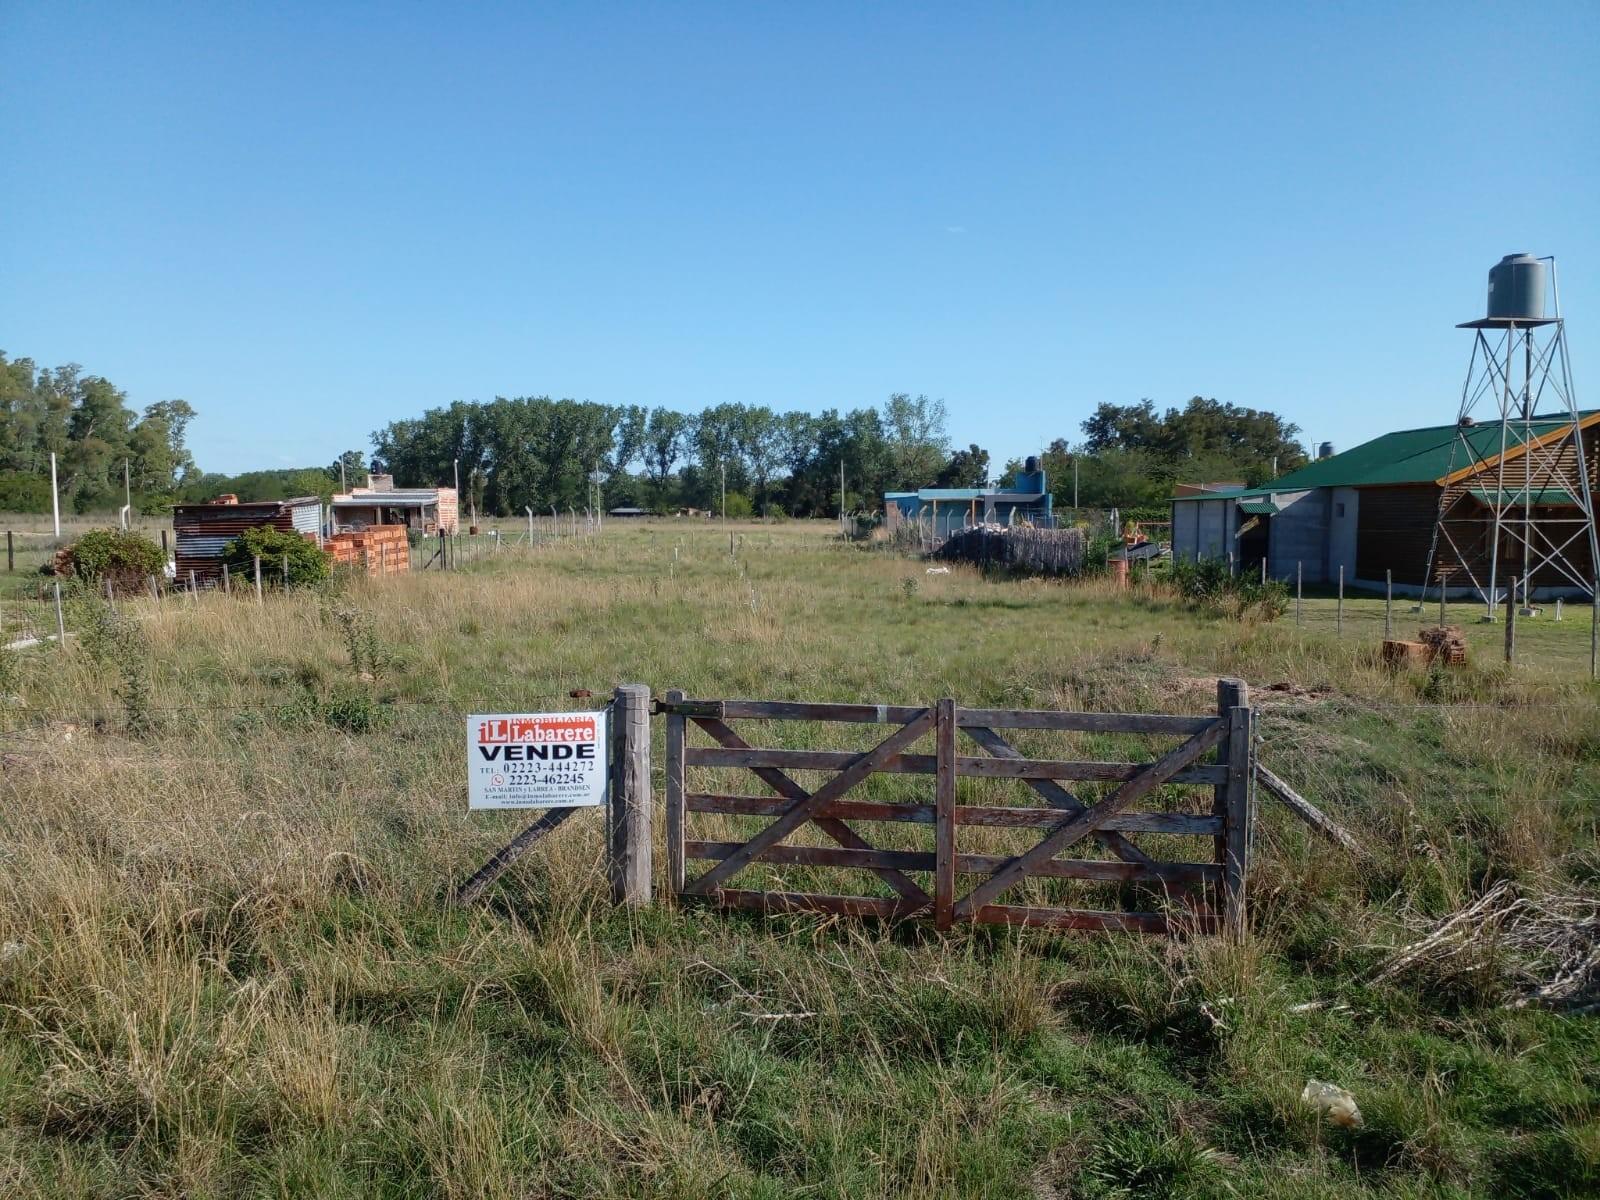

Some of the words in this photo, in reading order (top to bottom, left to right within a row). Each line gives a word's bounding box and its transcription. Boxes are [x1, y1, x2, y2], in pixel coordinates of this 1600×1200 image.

[511, 716, 595, 725] INMOBILIARIA
[512, 724, 594, 742] Labarere
[478, 744, 595, 761] VENDE
[503, 761, 594, 774] 02223-444272
[509, 773, 584, 786] 2223-462245
